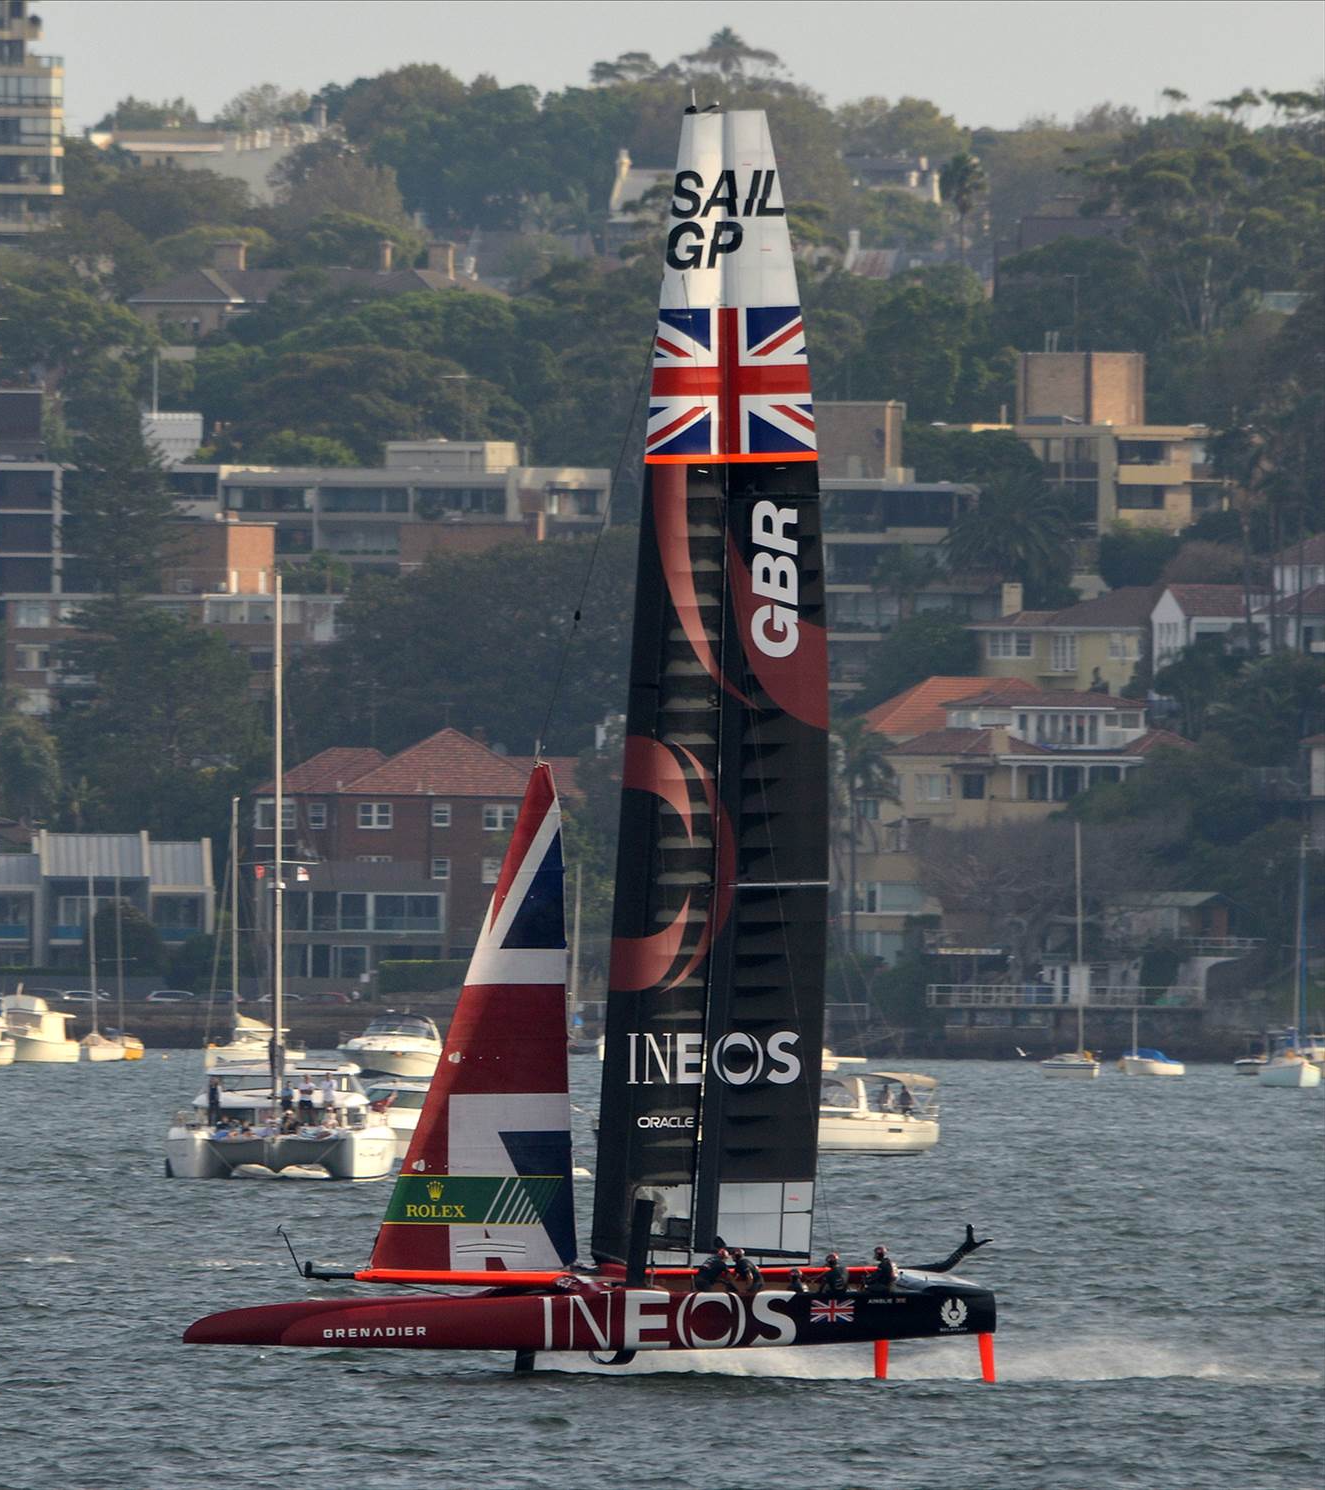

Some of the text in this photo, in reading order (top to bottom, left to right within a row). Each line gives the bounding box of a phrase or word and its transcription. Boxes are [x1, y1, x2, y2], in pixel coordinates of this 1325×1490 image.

[671, 170, 785, 219] SAIL
[666, 221, 744, 270] GP
[751, 500, 799, 658] GBR
[626, 1031, 801, 1085] INEOS
[637, 1116, 694, 1128] ORACLE
[406, 1204, 466, 1218] ROLEX
[323, 1326, 426, 1338] GRENADIER
[538, 1290, 797, 1350] INEOS
